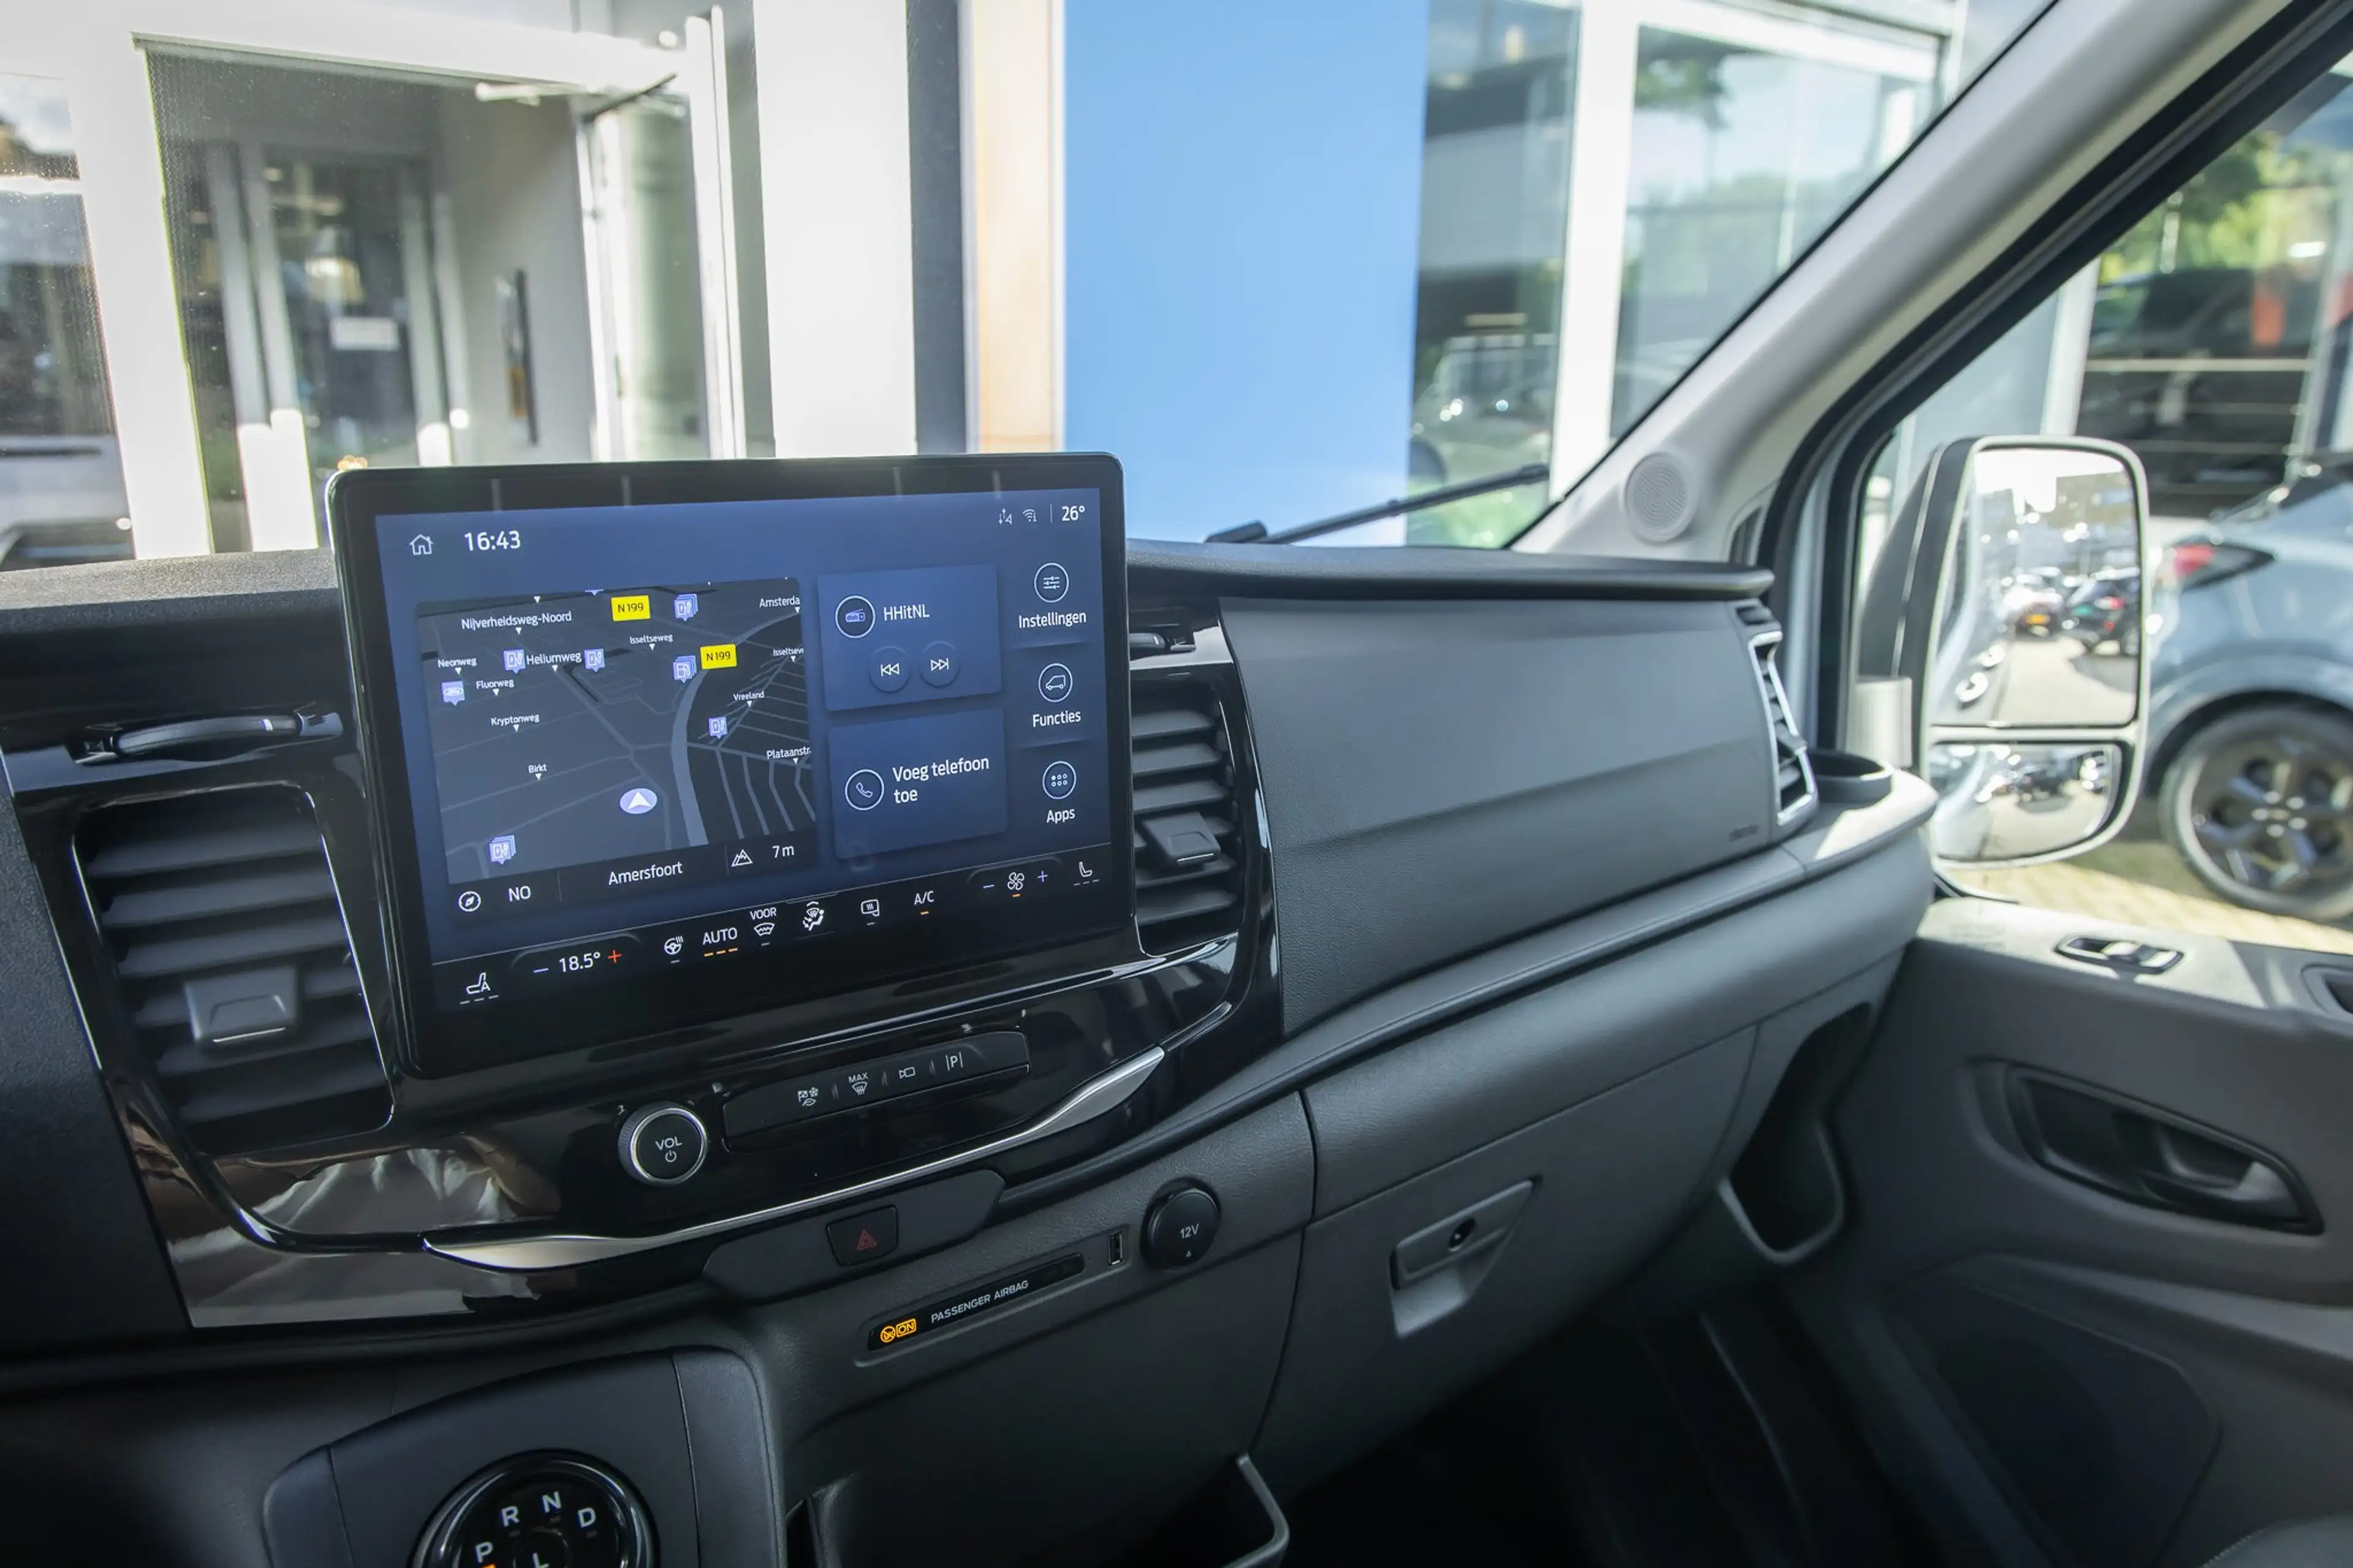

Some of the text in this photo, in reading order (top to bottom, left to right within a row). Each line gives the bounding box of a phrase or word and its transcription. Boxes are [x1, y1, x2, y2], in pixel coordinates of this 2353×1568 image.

[1062, 506, 1085, 521] 26°
[464, 531, 520, 551] 16:43
[627, 603, 643, 612] 199
[884, 604, 930, 621] HHitNL
[1019, 612, 1086, 628] Instellingen
[630, 635, 673, 644] Isseltseweg
[438, 659, 477, 668] Neonweg
[526, 653, 582, 665] Heliumweg
[476, 680, 514, 689] Fluorweg
[733, 691, 764, 700] Vreeland
[491, 715, 539, 726] Kryptonweg
[1033, 710, 1080, 727] Functies
[529, 764, 547, 773] Birkt
[893, 757, 988, 781] Voeg telefoon
[894, 789, 917, 803] toe
[1047, 809, 1075, 824] Apps
[609, 862, 683, 885] Amersfoort
[509, 886, 530, 901] NO
[914, 891, 934, 904] A/C
[750, 907, 776, 920] VOOR
[703, 928, 737, 945] AUTO
[559, 952, 600, 972] 18.5°
[849, 1073, 868, 1084] MAX
[656, 1137, 682, 1150] VOL
[1180, 1224, 1199, 1238] 12V
[931, 1295, 990, 1323] PASSENGER
[994, 1281, 1028, 1300] AIRBAG
[542, 1492, 561, 1512] N
[502, 1506, 518, 1526] R
[578, 1508, 596, 1527] D
[476, 1542, 492, 1562] P
